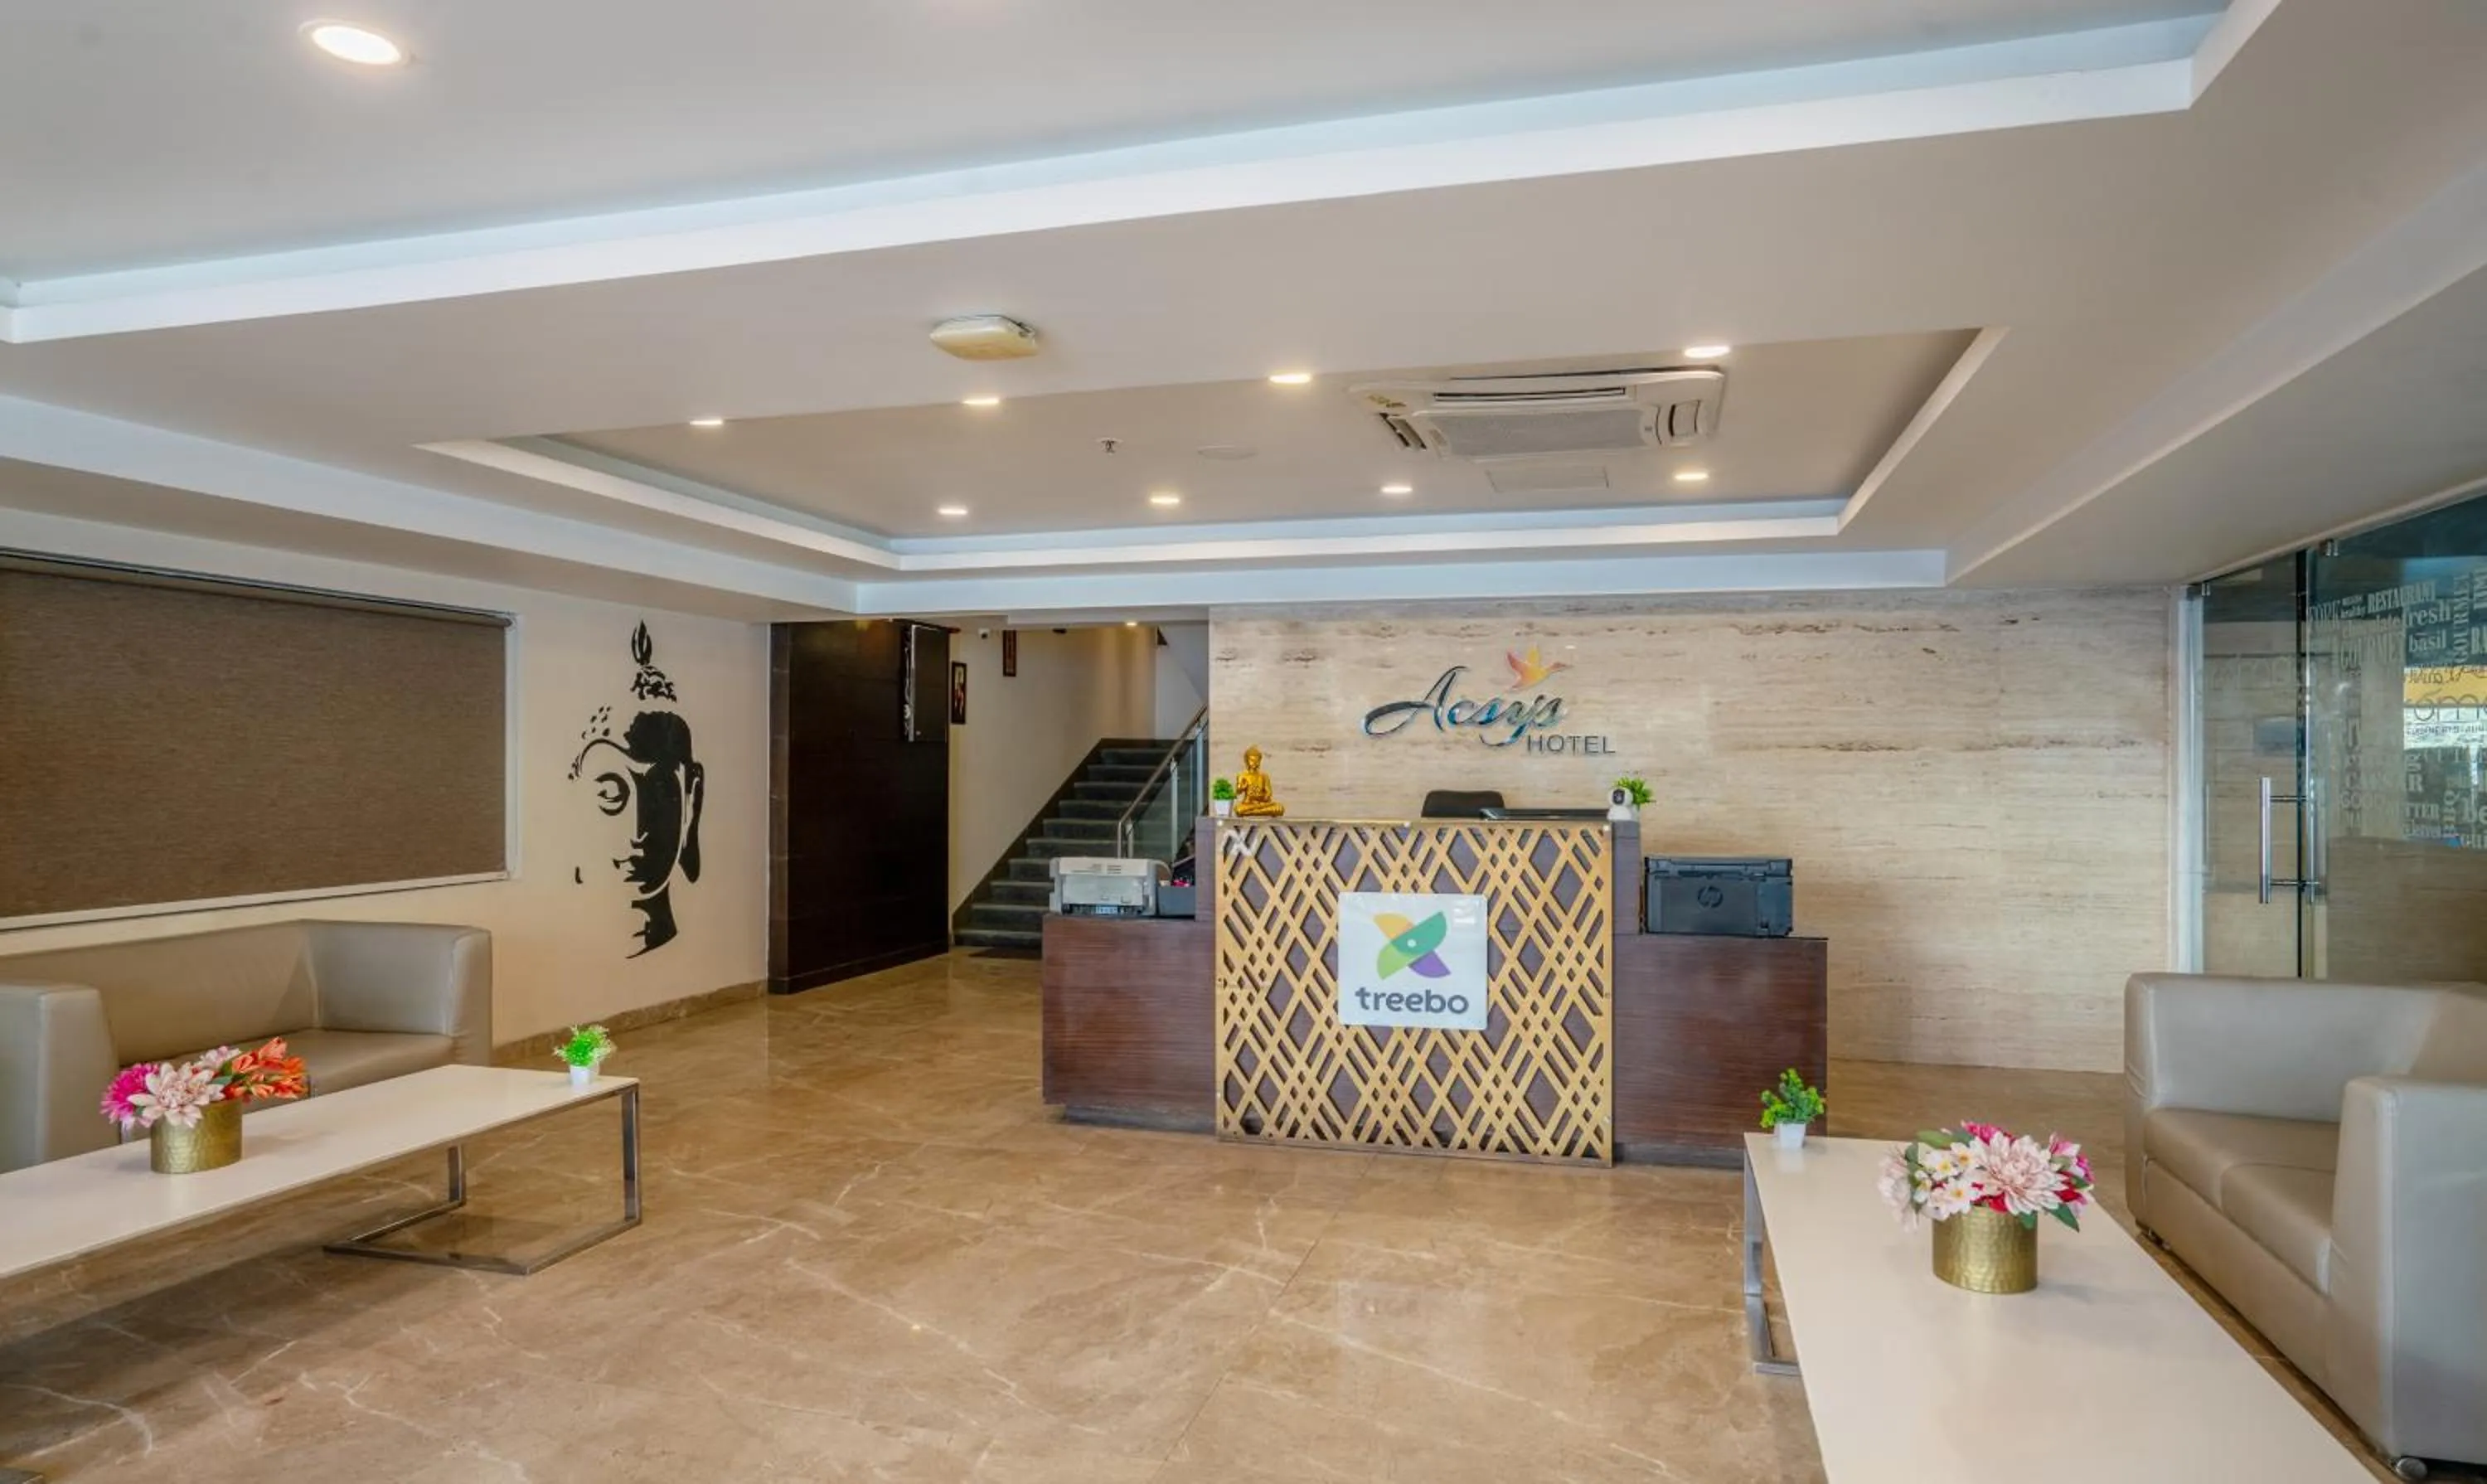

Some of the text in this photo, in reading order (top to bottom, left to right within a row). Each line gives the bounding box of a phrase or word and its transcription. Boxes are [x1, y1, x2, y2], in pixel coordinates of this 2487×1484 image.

[2367, 580, 2437, 614] RESTAURANT
[2402, 598, 2452, 628] fresh
[2408, 628, 2447, 652] basil
[1527, 735, 1616, 754] HOTEL
[1355, 987, 1470, 1015] treebo
